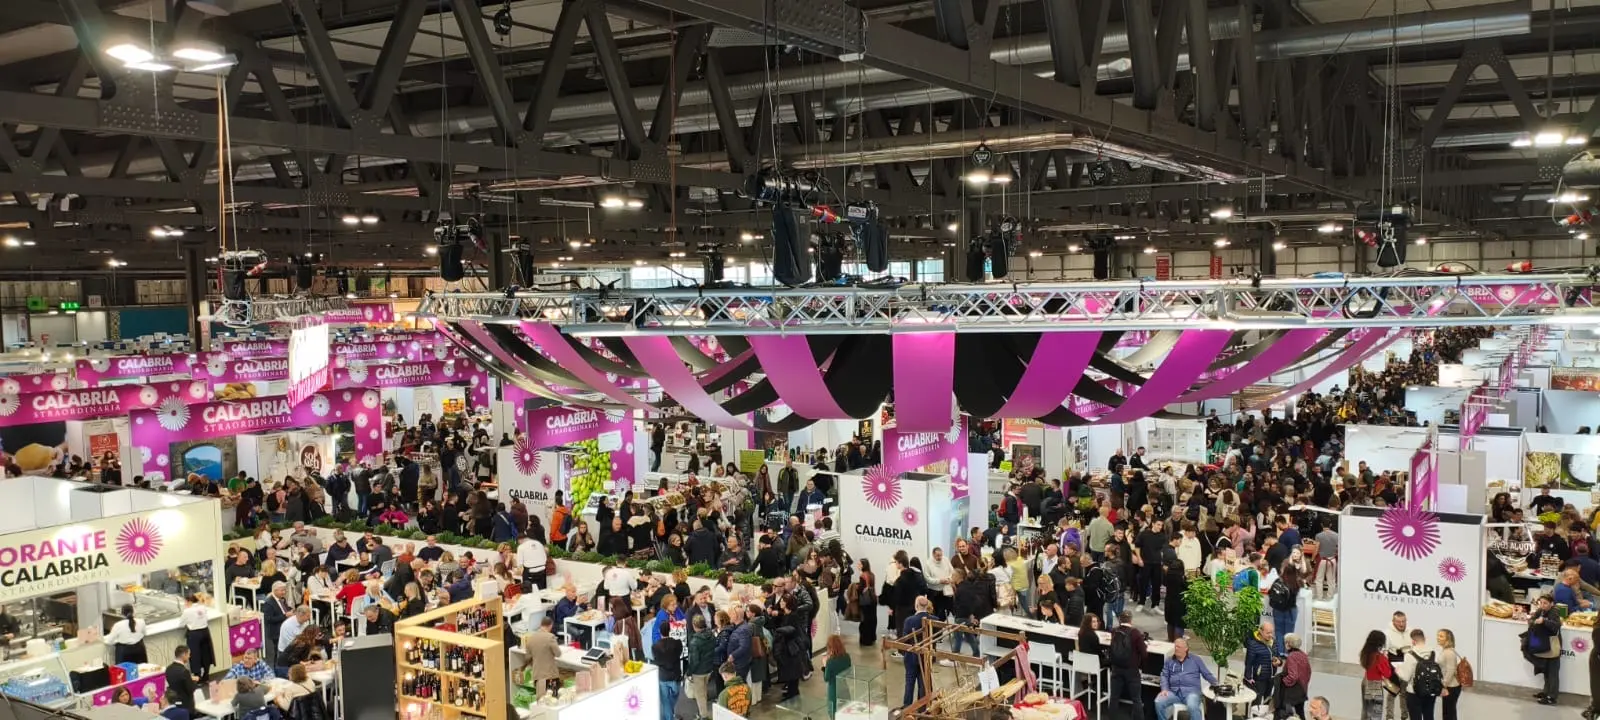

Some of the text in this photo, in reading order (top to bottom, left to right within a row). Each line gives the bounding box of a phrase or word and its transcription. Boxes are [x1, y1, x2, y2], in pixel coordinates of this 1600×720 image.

[231, 342, 272, 352] CALABRIA
[336, 343, 377, 354] CALABRIA
[118, 357, 173, 369] CALABRIA
[234, 360, 288, 374] CALABRIA
[376, 364, 431, 379] CALABRIA
[32, 390, 120, 411] CALABRIA
[33, 405, 121, 418] STRAORDINARIA
[203, 399, 291, 424] CALABRIA
[546, 410, 598, 429] CALABRIA
[203, 416, 292, 433] STRAORDINARIA
[898, 431, 939, 452] CALABRIA
[508, 488, 549, 500] CALABRIA
[855, 524, 912, 541] CALABRIA
[0, 552, 109, 587] CALABRIA
[1363, 578, 1455, 601] CALABRIA
